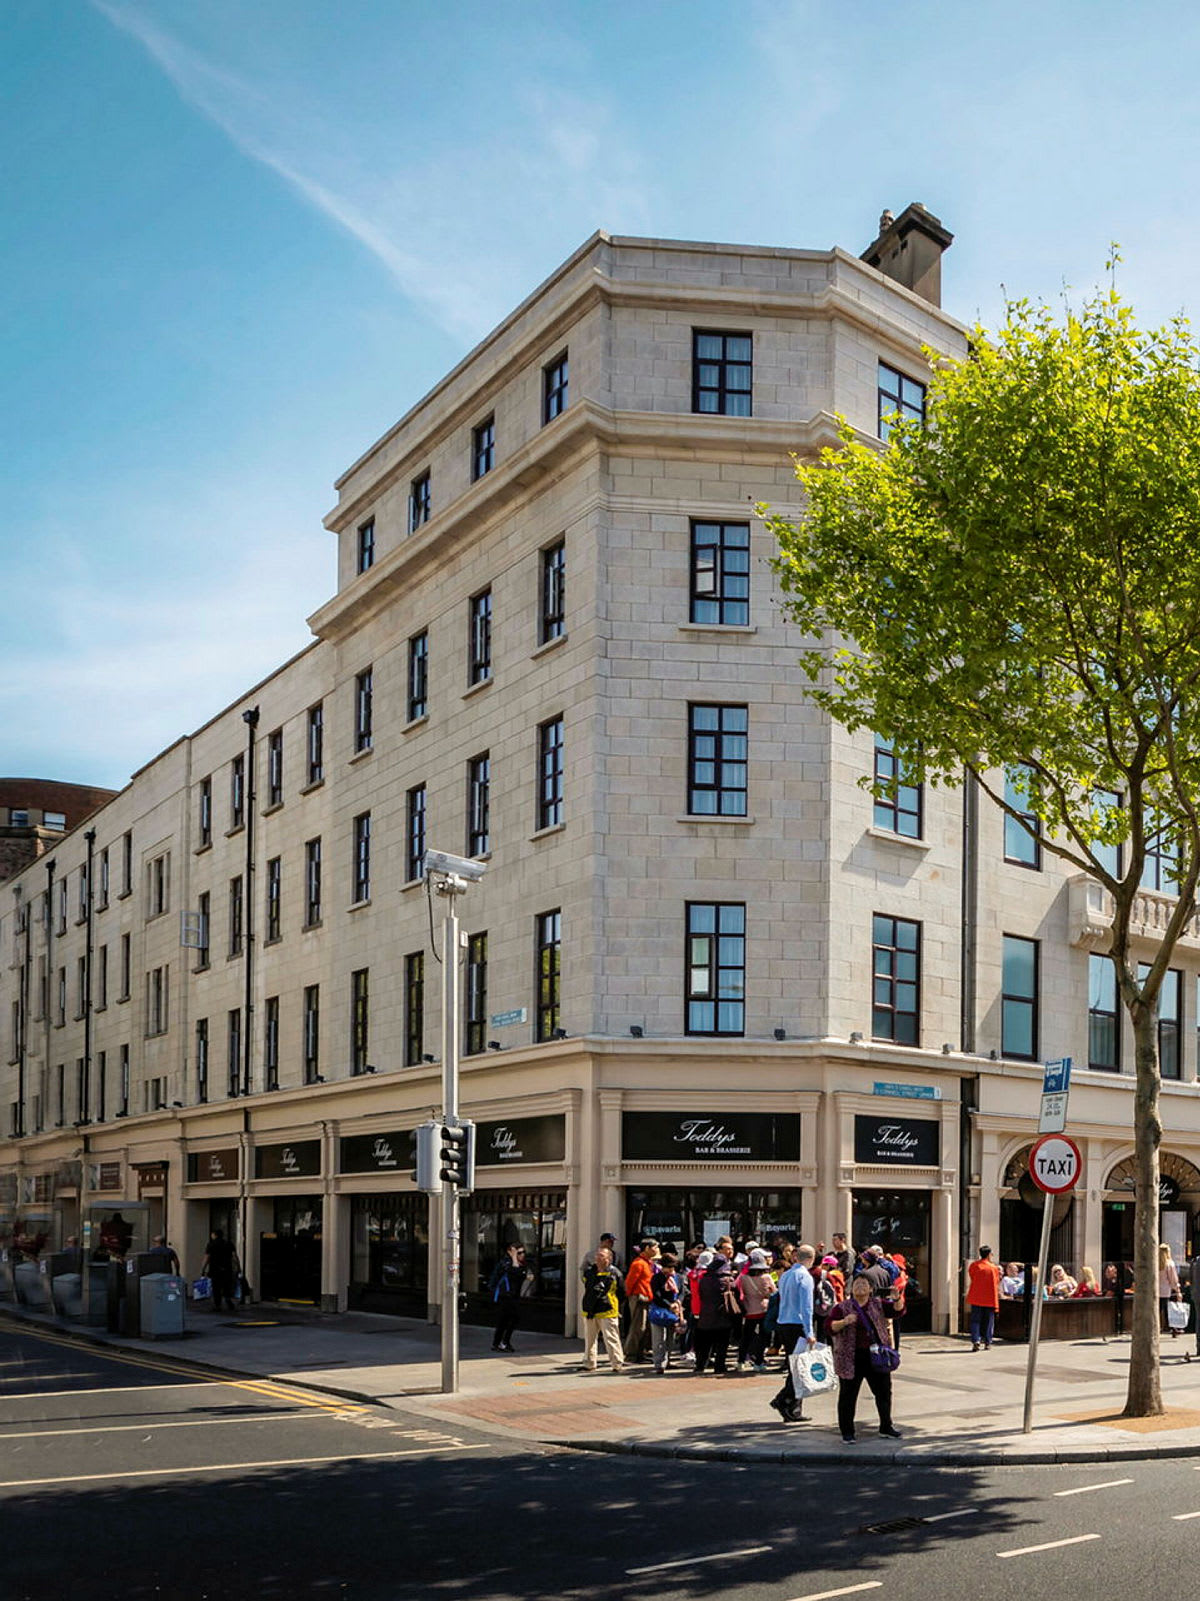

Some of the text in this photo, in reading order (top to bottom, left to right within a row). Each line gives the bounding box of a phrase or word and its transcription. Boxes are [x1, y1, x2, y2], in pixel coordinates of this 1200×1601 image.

[673, 1119, 736, 1148] Toddys
[872, 1125, 919, 1151] Toddys
[1038, 1159, 1072, 1176] TAXI
